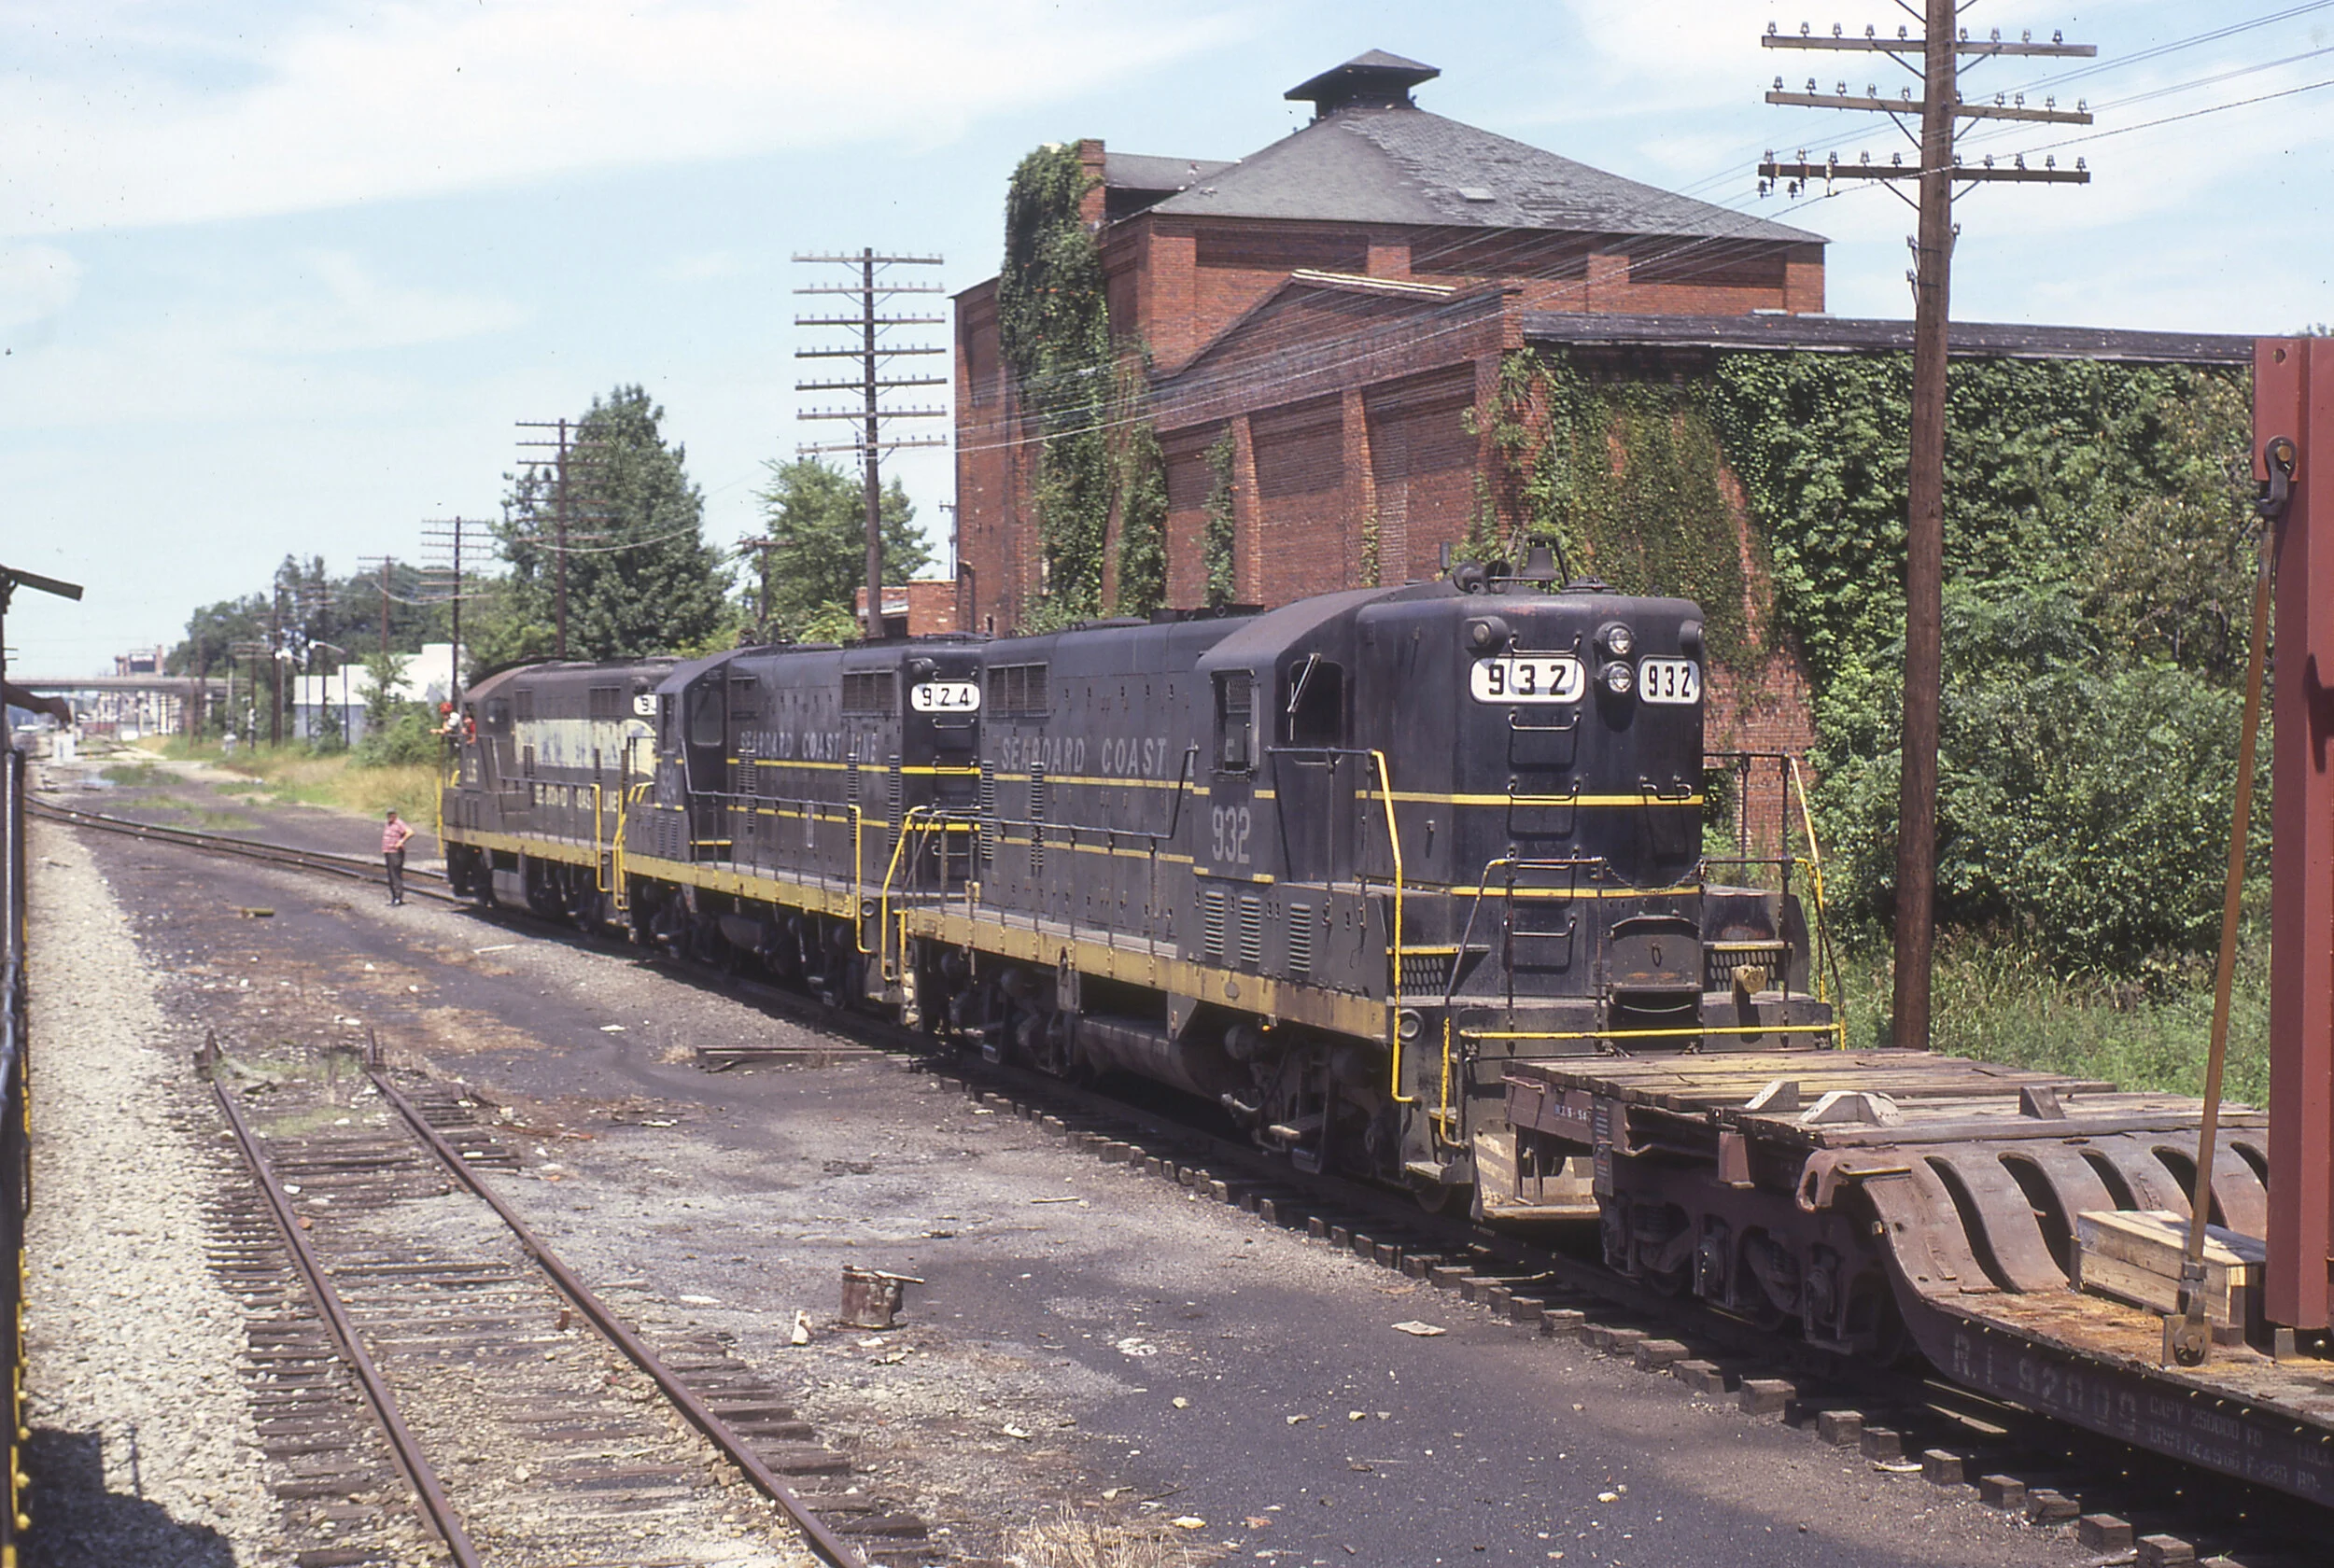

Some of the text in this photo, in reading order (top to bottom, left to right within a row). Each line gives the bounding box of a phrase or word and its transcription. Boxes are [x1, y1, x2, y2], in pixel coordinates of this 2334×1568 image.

[1487, 664, 1567, 695] 932
[1648, 665, 1692, 697] 932
[921, 686, 970, 707] 924
[802, 732, 840, 761] COAST
[1001, 735, 1086, 774] SEABOARD
[1101, 737, 1167, 777] COAST
[1211, 805, 1251, 864] 932
